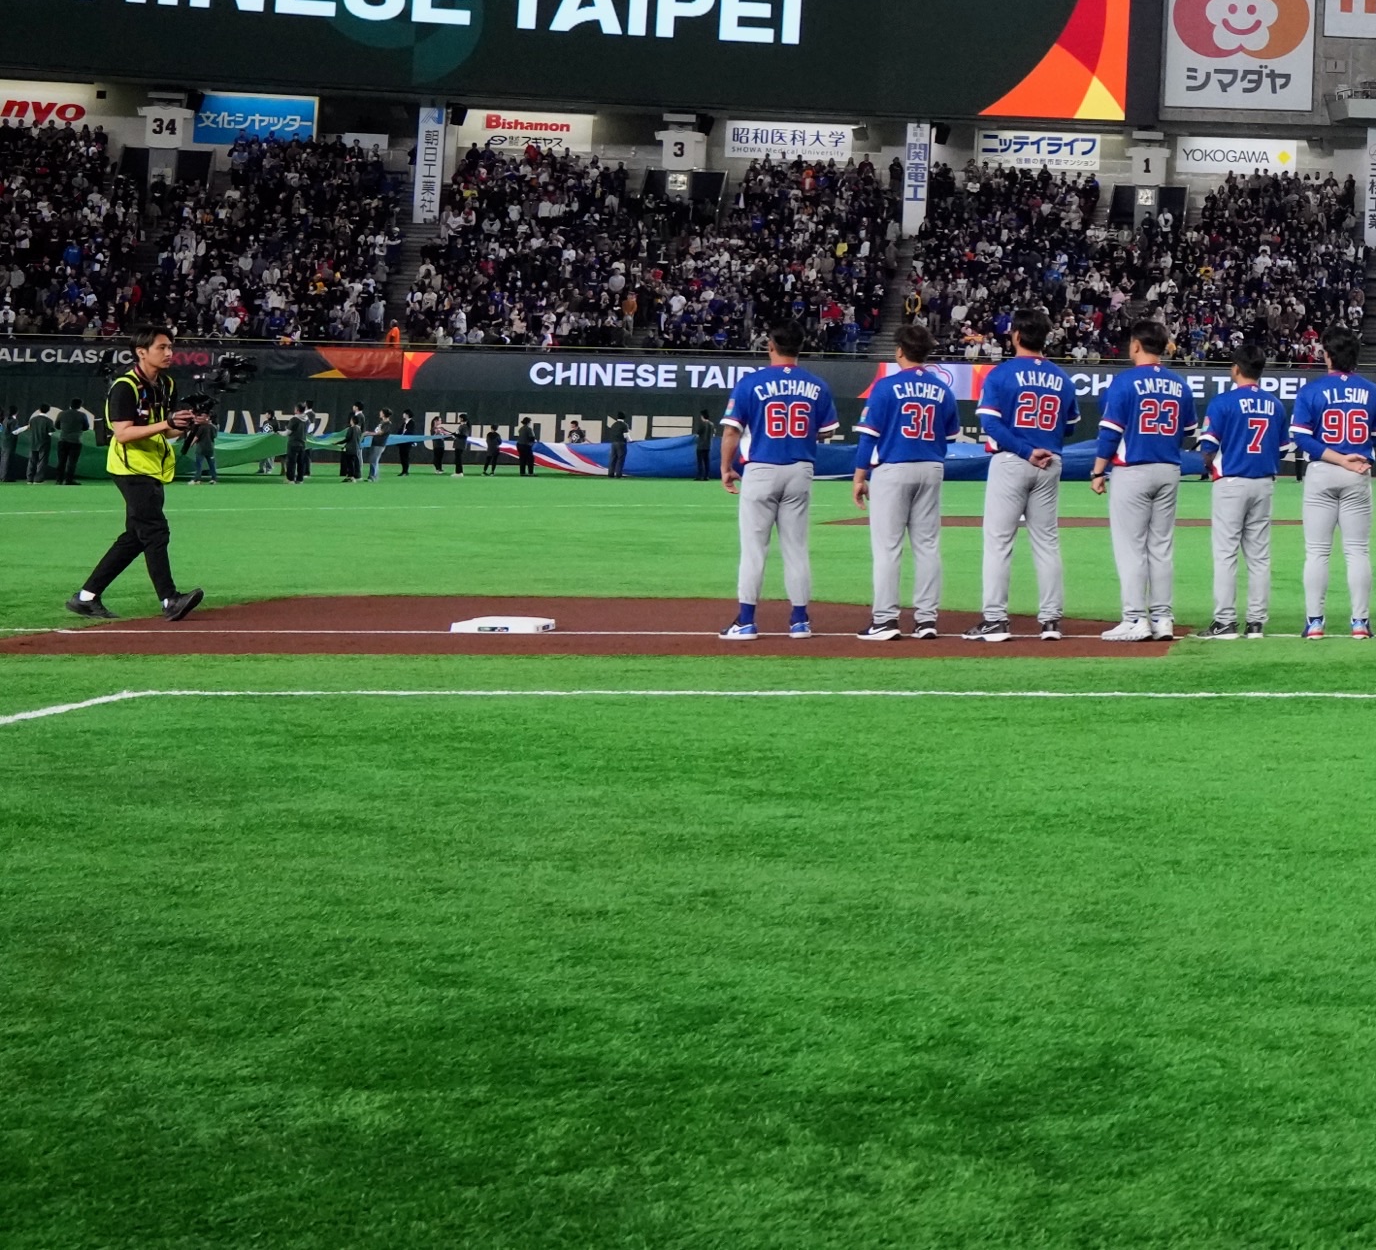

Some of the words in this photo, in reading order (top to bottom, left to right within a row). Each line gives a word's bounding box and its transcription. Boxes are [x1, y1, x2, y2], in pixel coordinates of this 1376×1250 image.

[1185, 65, 1292, 94] シマダヤ
[153, 117, 177, 135] 34
[485, 113, 571, 132] Bishamon
[673, 141, 683, 157] 3
[733, 126, 846, 147] 昭和医科大学
[982, 134, 1097, 155] ニッテイライフ
[1142, 155, 1153, 174] 1
[1183, 149, 1270, 163] YOKOGAWA
[420, 130, 439, 213] 朝日工業社
[905, 143, 929, 202] 関電工
[41, 349, 134, 364] CLASIC
[530, 362, 677, 387] CHINESE
[893, 383, 945, 404] C.H.CHEN
[765, 401, 811, 439] 66
[901, 402, 935, 441] 31
[1014, 392, 1061, 432] 28
[1139, 398, 1179, 436] 23
[1247, 418, 1268, 453] 7
[1321, 408, 1369, 444] 96
